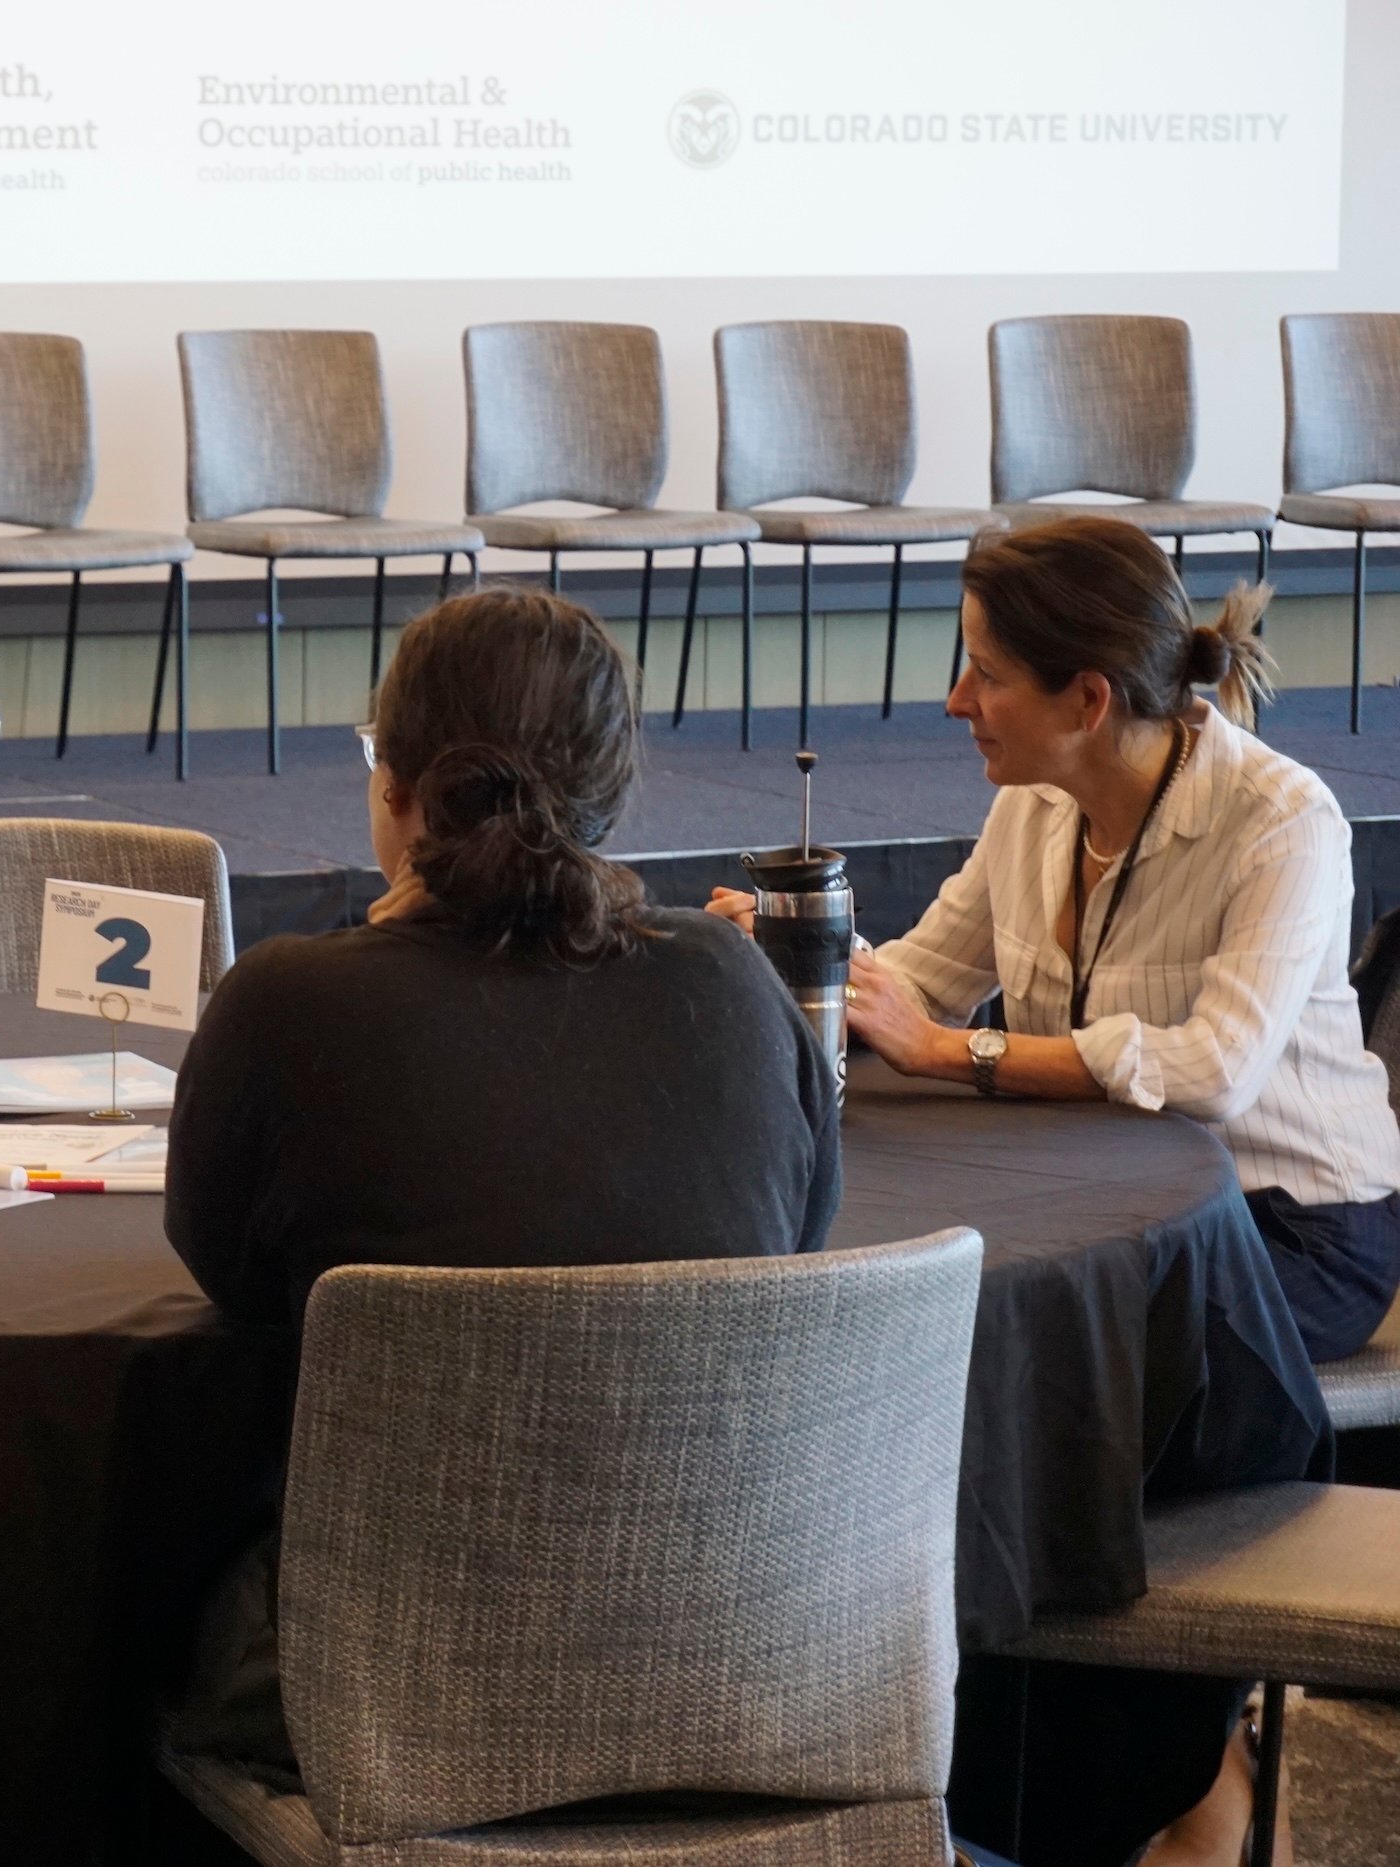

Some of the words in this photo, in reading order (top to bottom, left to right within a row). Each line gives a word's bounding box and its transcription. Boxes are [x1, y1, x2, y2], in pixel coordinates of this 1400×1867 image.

[197, 74, 471, 107] Environmental
[480, 75, 507, 107] &
[197, 116, 441, 156] Occupational
[453, 117, 573, 150] Health
[751, 112, 950, 144] COLORADO
[959, 112, 1069, 144] STATE
[1078, 112, 1290, 144] UNIVERSITY
[196, 161, 303, 184] colorado
[305, 161, 386, 184] school
[389, 160, 414, 184] of
[417, 161, 494, 187] public
[497, 160, 573, 183] health
[94, 916, 152, 991] 2
